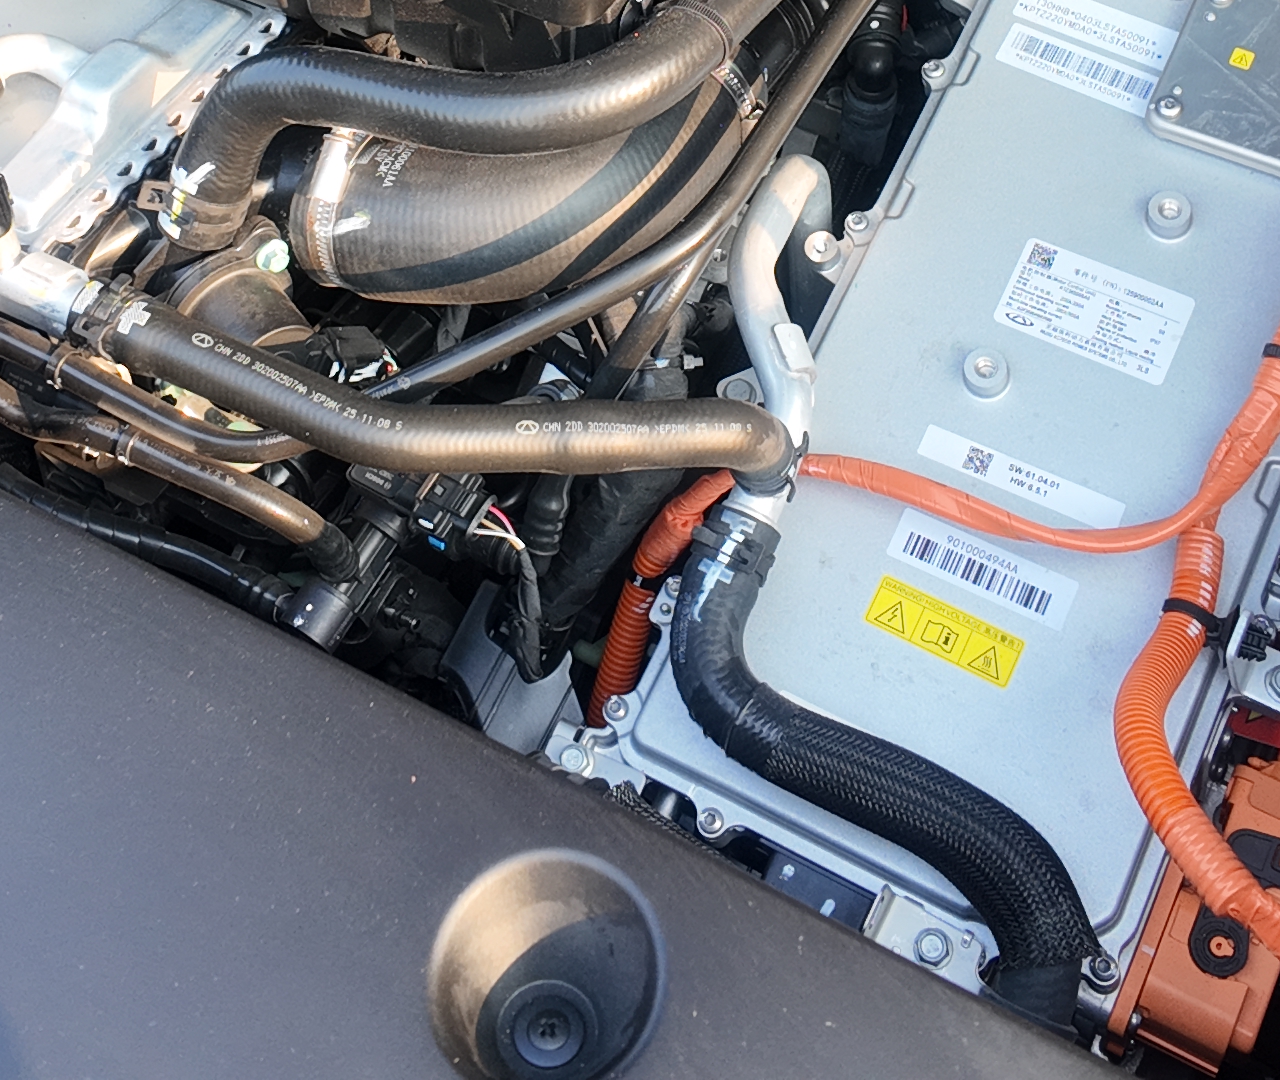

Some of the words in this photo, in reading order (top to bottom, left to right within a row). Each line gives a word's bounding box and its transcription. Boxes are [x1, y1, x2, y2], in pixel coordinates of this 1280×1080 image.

[214, 343, 232, 356] CHN
[543, 421, 561, 432] CHN
[946, 535, 1018, 574] 901000494AA
